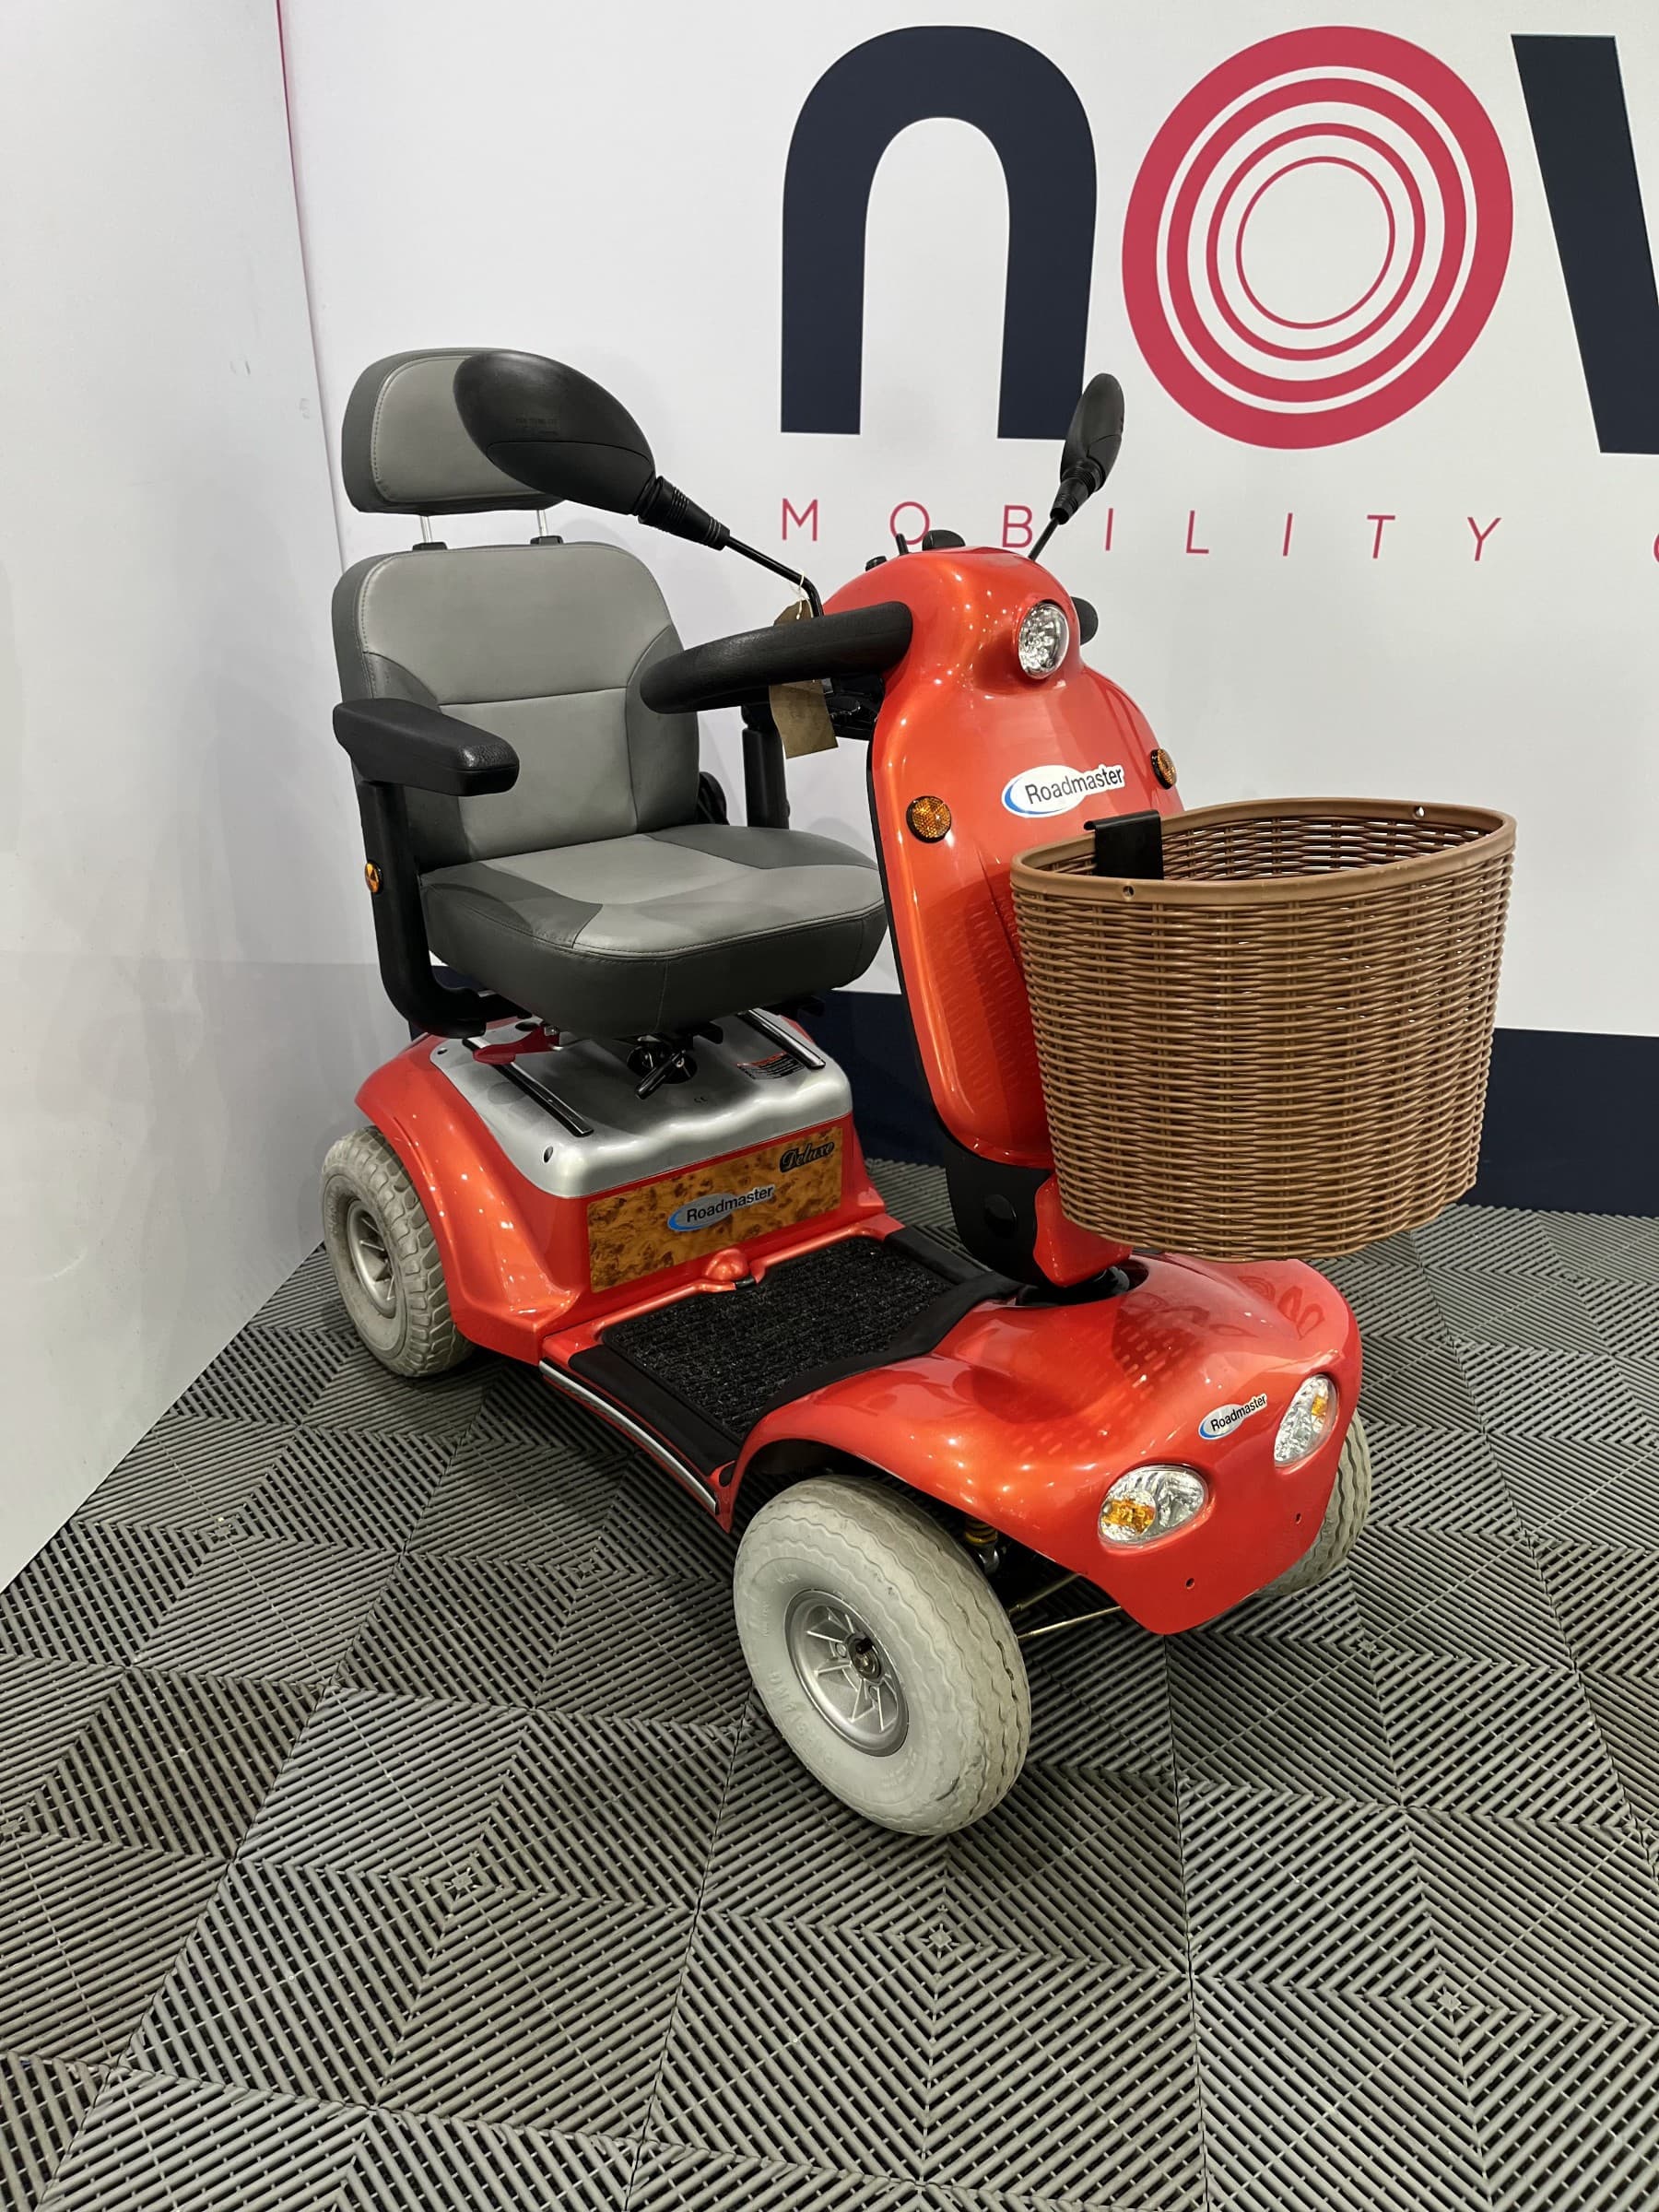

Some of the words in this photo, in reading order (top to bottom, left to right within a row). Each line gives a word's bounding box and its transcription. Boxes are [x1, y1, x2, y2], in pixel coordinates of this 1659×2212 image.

[782, 498, 1502, 562] MOBILITY
[1024, 768, 1124, 805] Roadmaster
[782, 1143, 833, 1169] Deluxe
[686, 1185, 774, 1223] Roadmaster
[1209, 1394, 1266, 1431] Roadmaster
